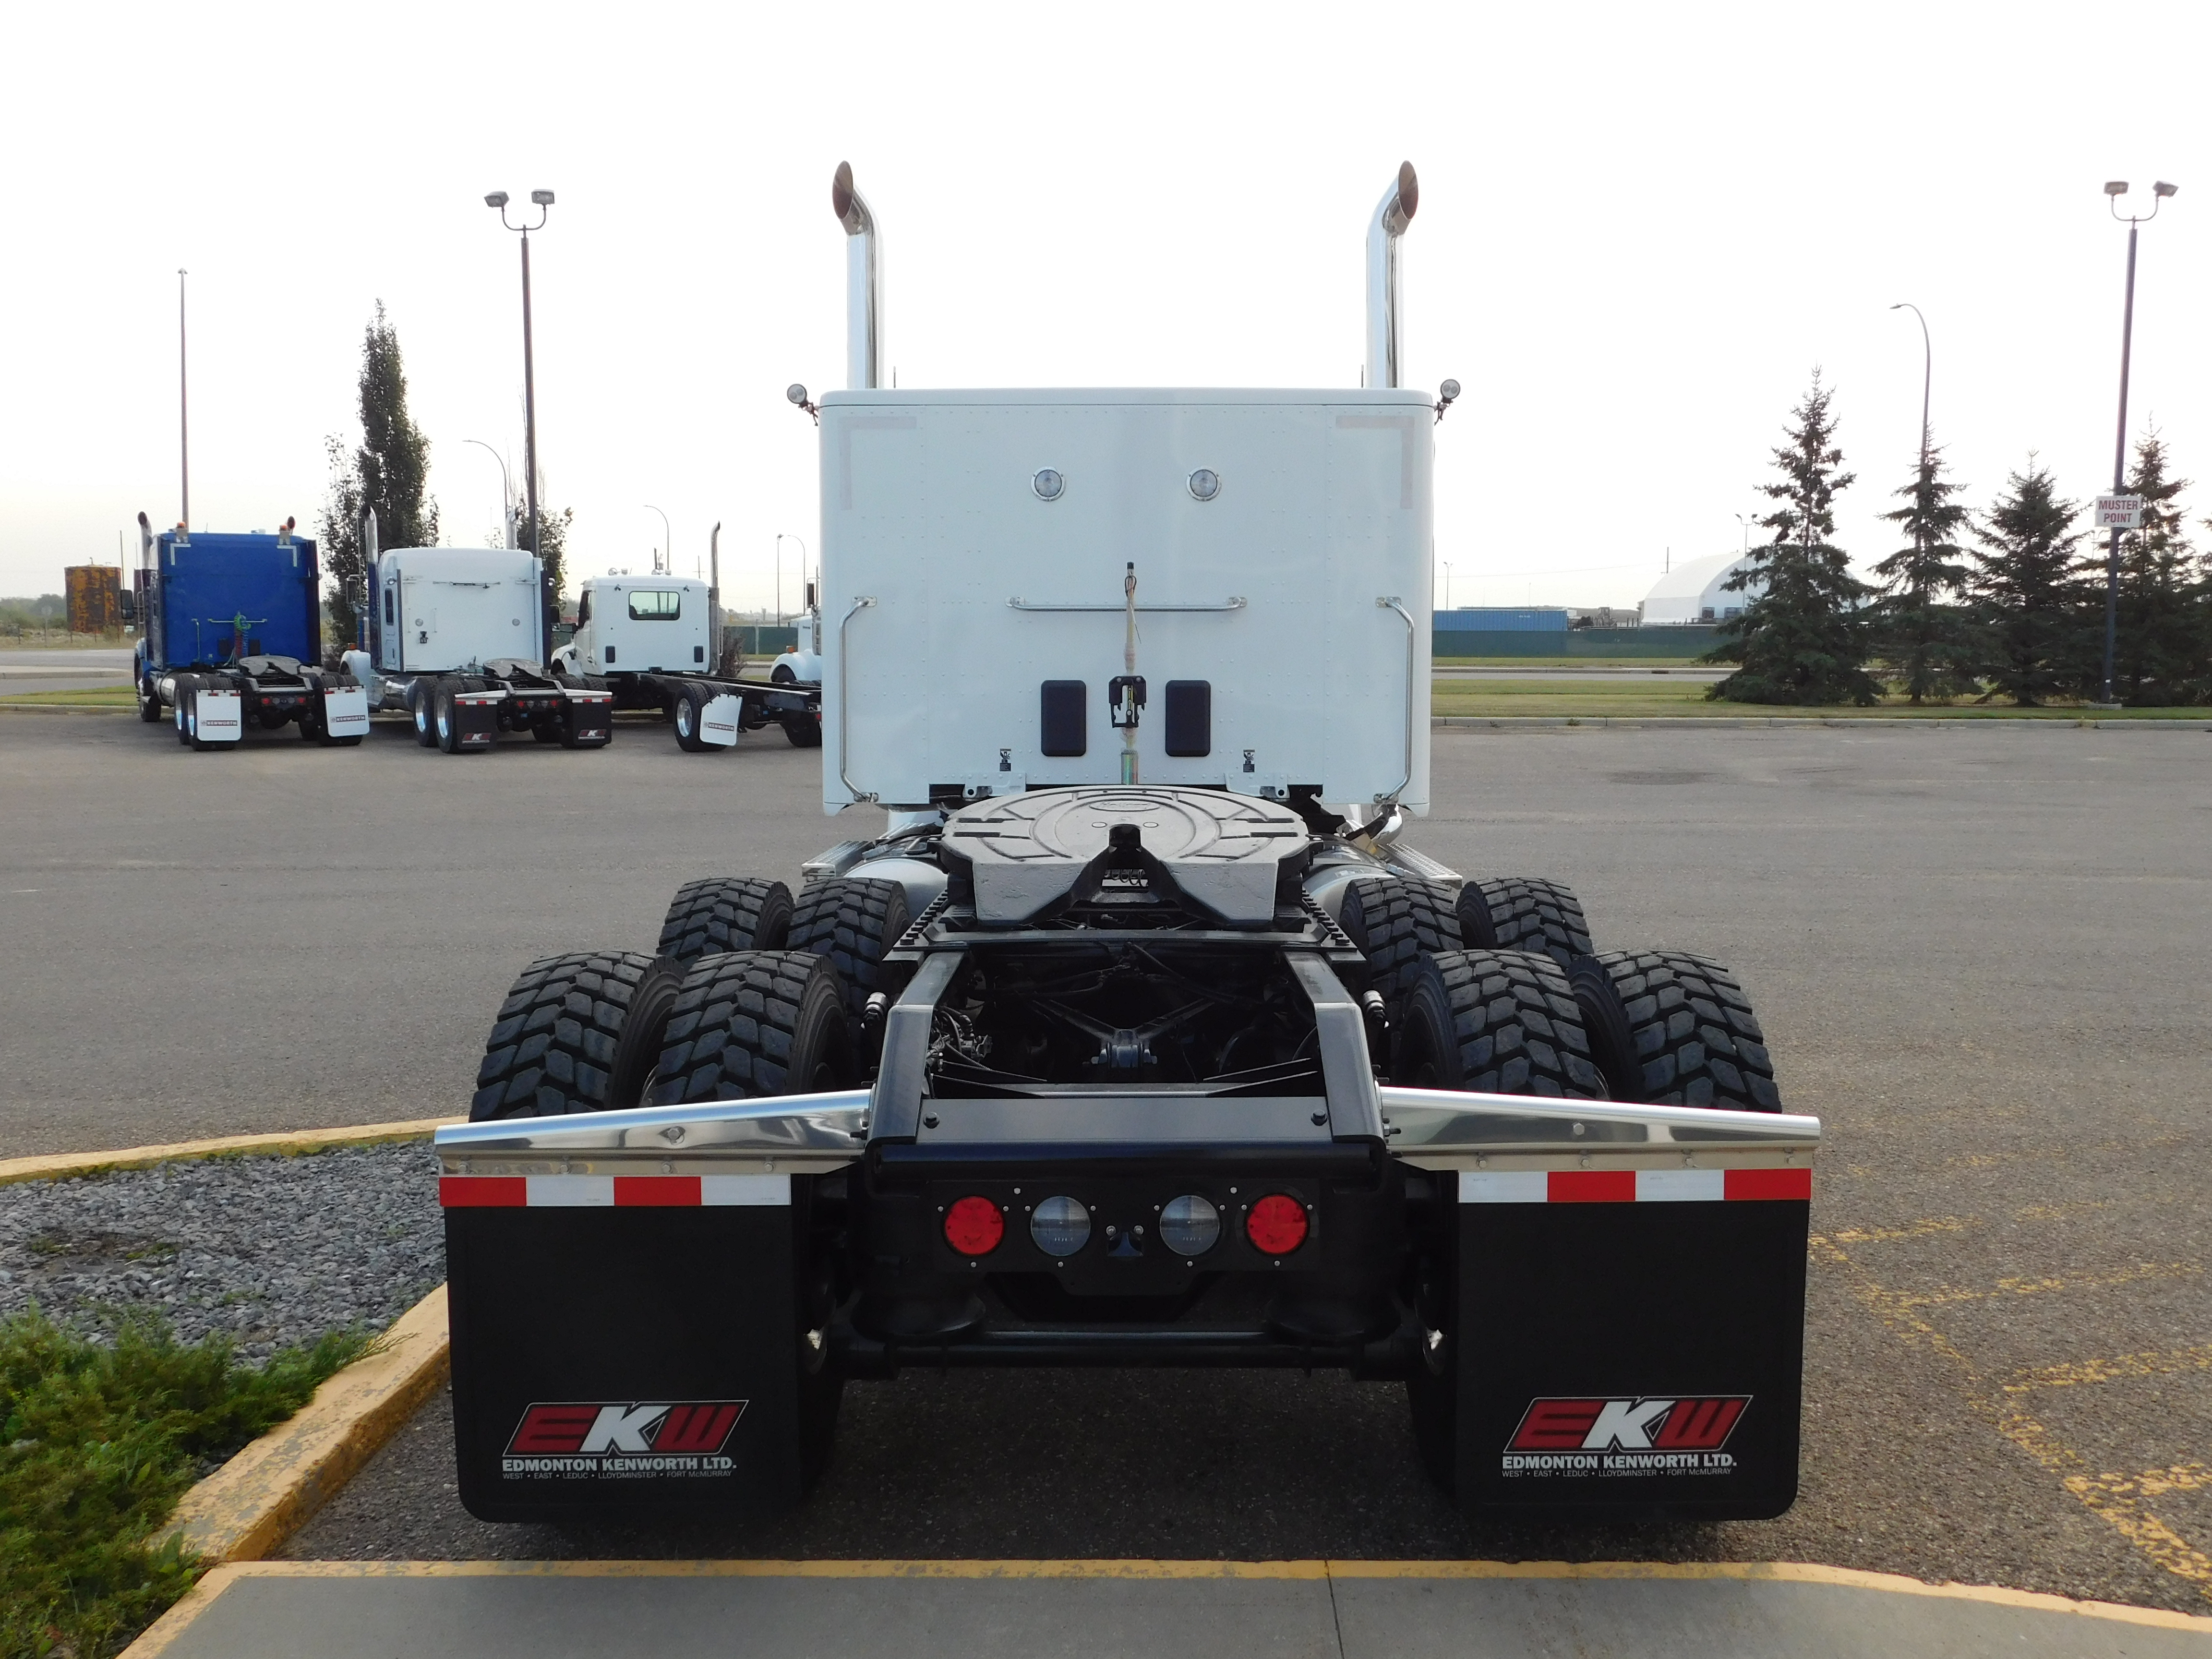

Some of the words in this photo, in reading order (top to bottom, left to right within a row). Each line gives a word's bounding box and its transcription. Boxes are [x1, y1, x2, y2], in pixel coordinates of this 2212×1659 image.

[2098, 500, 2138, 510] MUSTER
[2104, 513, 2132, 523] POINT
[502, 1459, 597, 1472] EDMONTON
[602, 1458, 698, 1471] KENWORTH
[703, 1457, 737, 1469] LTD.
[1503, 1456, 1598, 1469] EDMONTON
[1603, 1455, 1699, 1468] KENWORTH
[1703, 1454, 1737, 1467] LTD.
